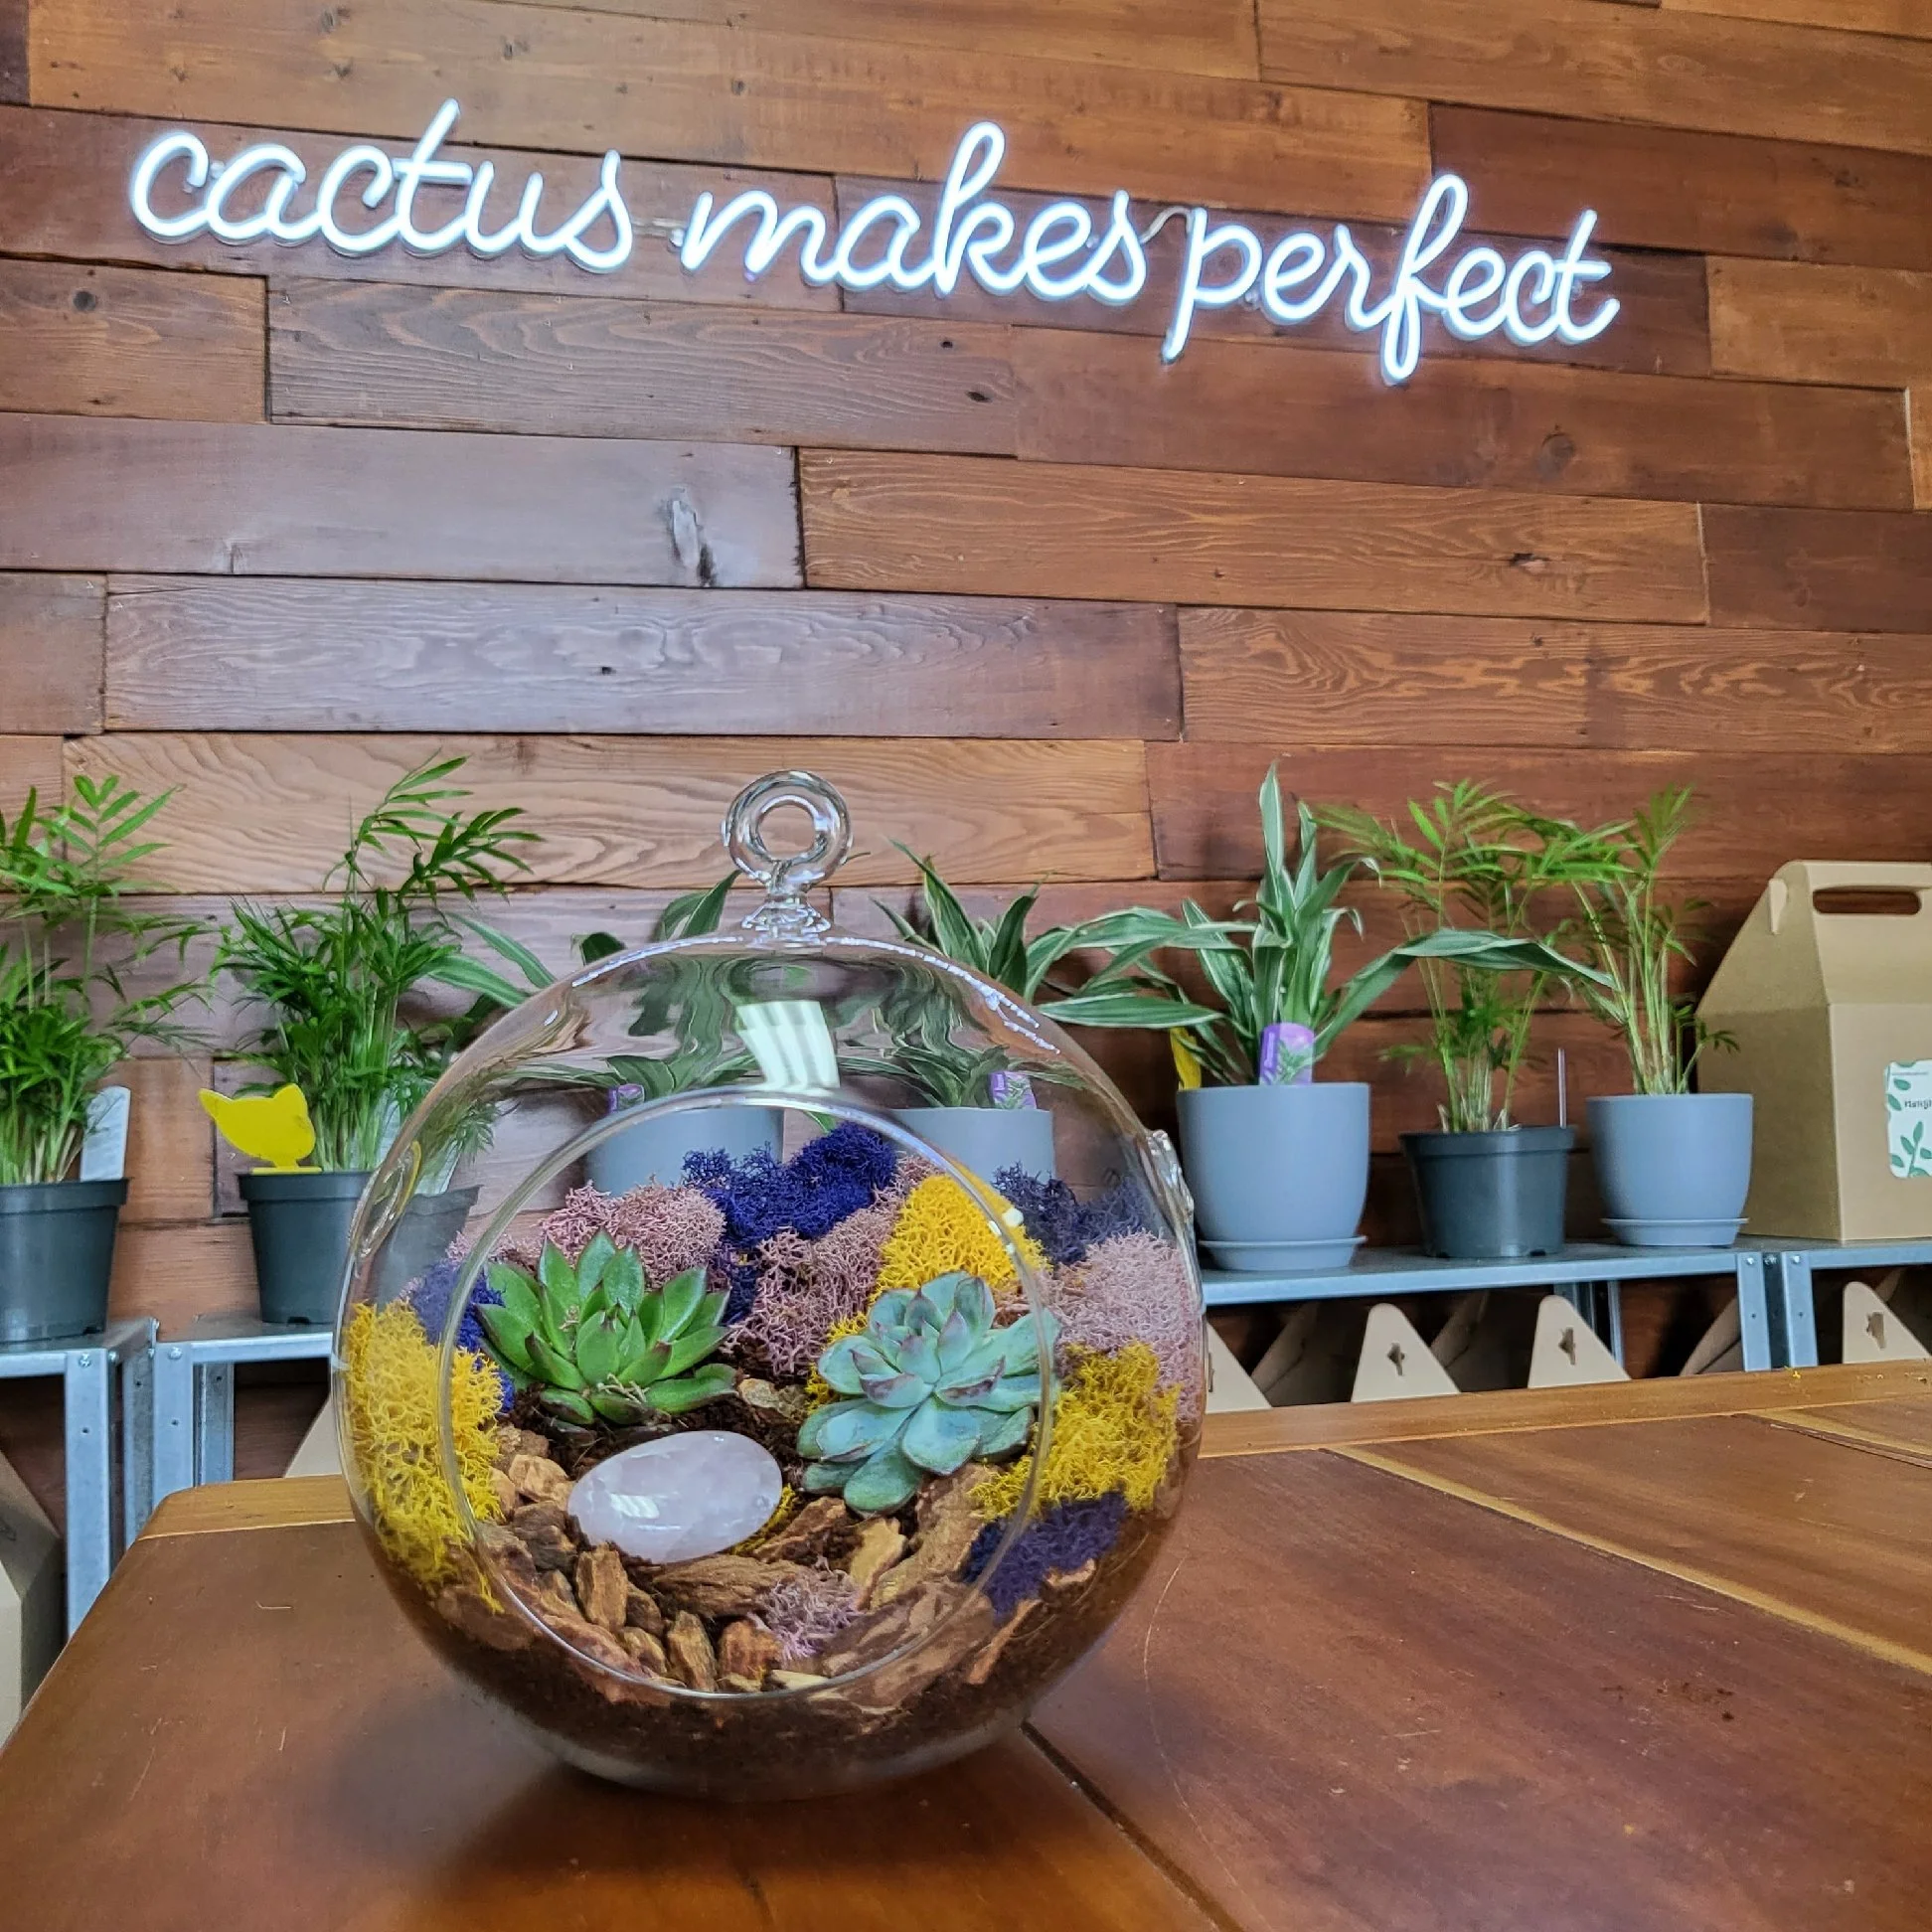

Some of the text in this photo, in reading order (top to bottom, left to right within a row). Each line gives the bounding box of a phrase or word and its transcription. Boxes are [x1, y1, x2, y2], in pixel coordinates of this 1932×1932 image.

[130, 98, 1621, 384] cactus makes perfect
